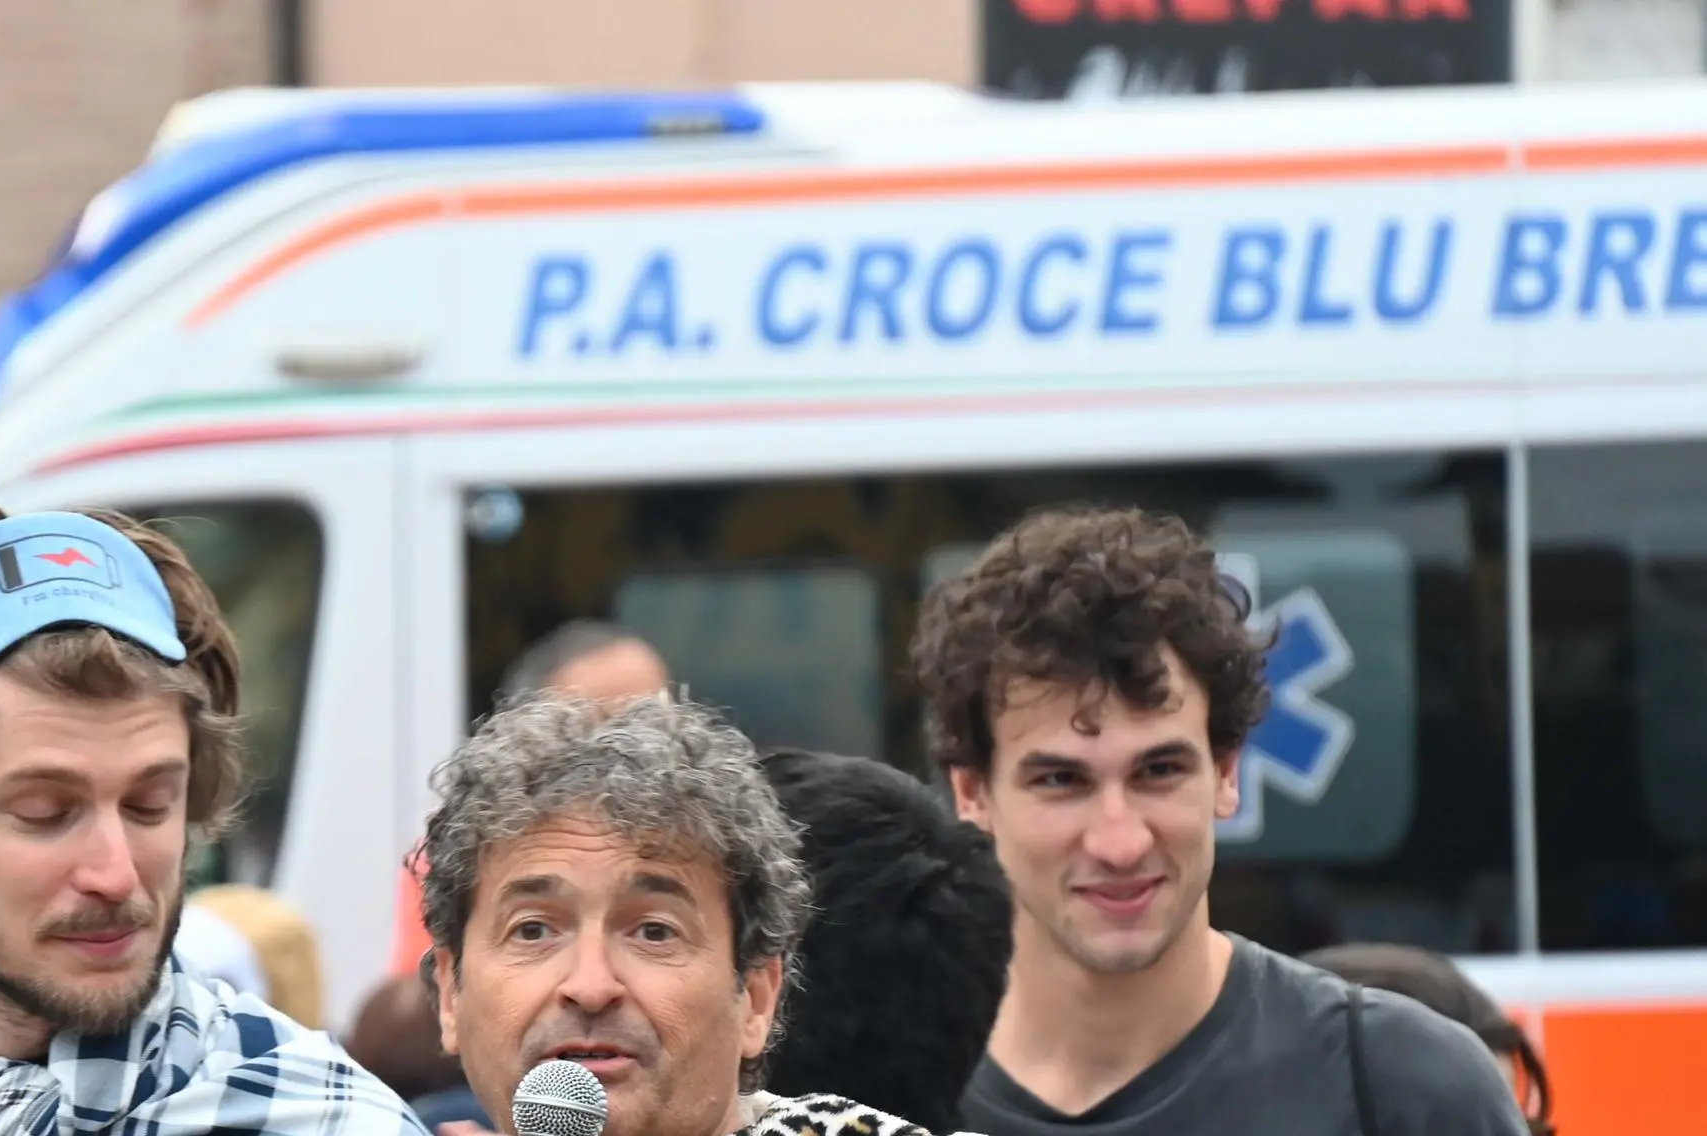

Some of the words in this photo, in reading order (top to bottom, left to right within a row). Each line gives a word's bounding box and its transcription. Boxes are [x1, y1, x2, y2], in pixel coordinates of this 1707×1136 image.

[517, 246, 714, 356] P.A.
[755, 228, 1171, 348] CROCE
[1209, 217, 1451, 330] BLU
